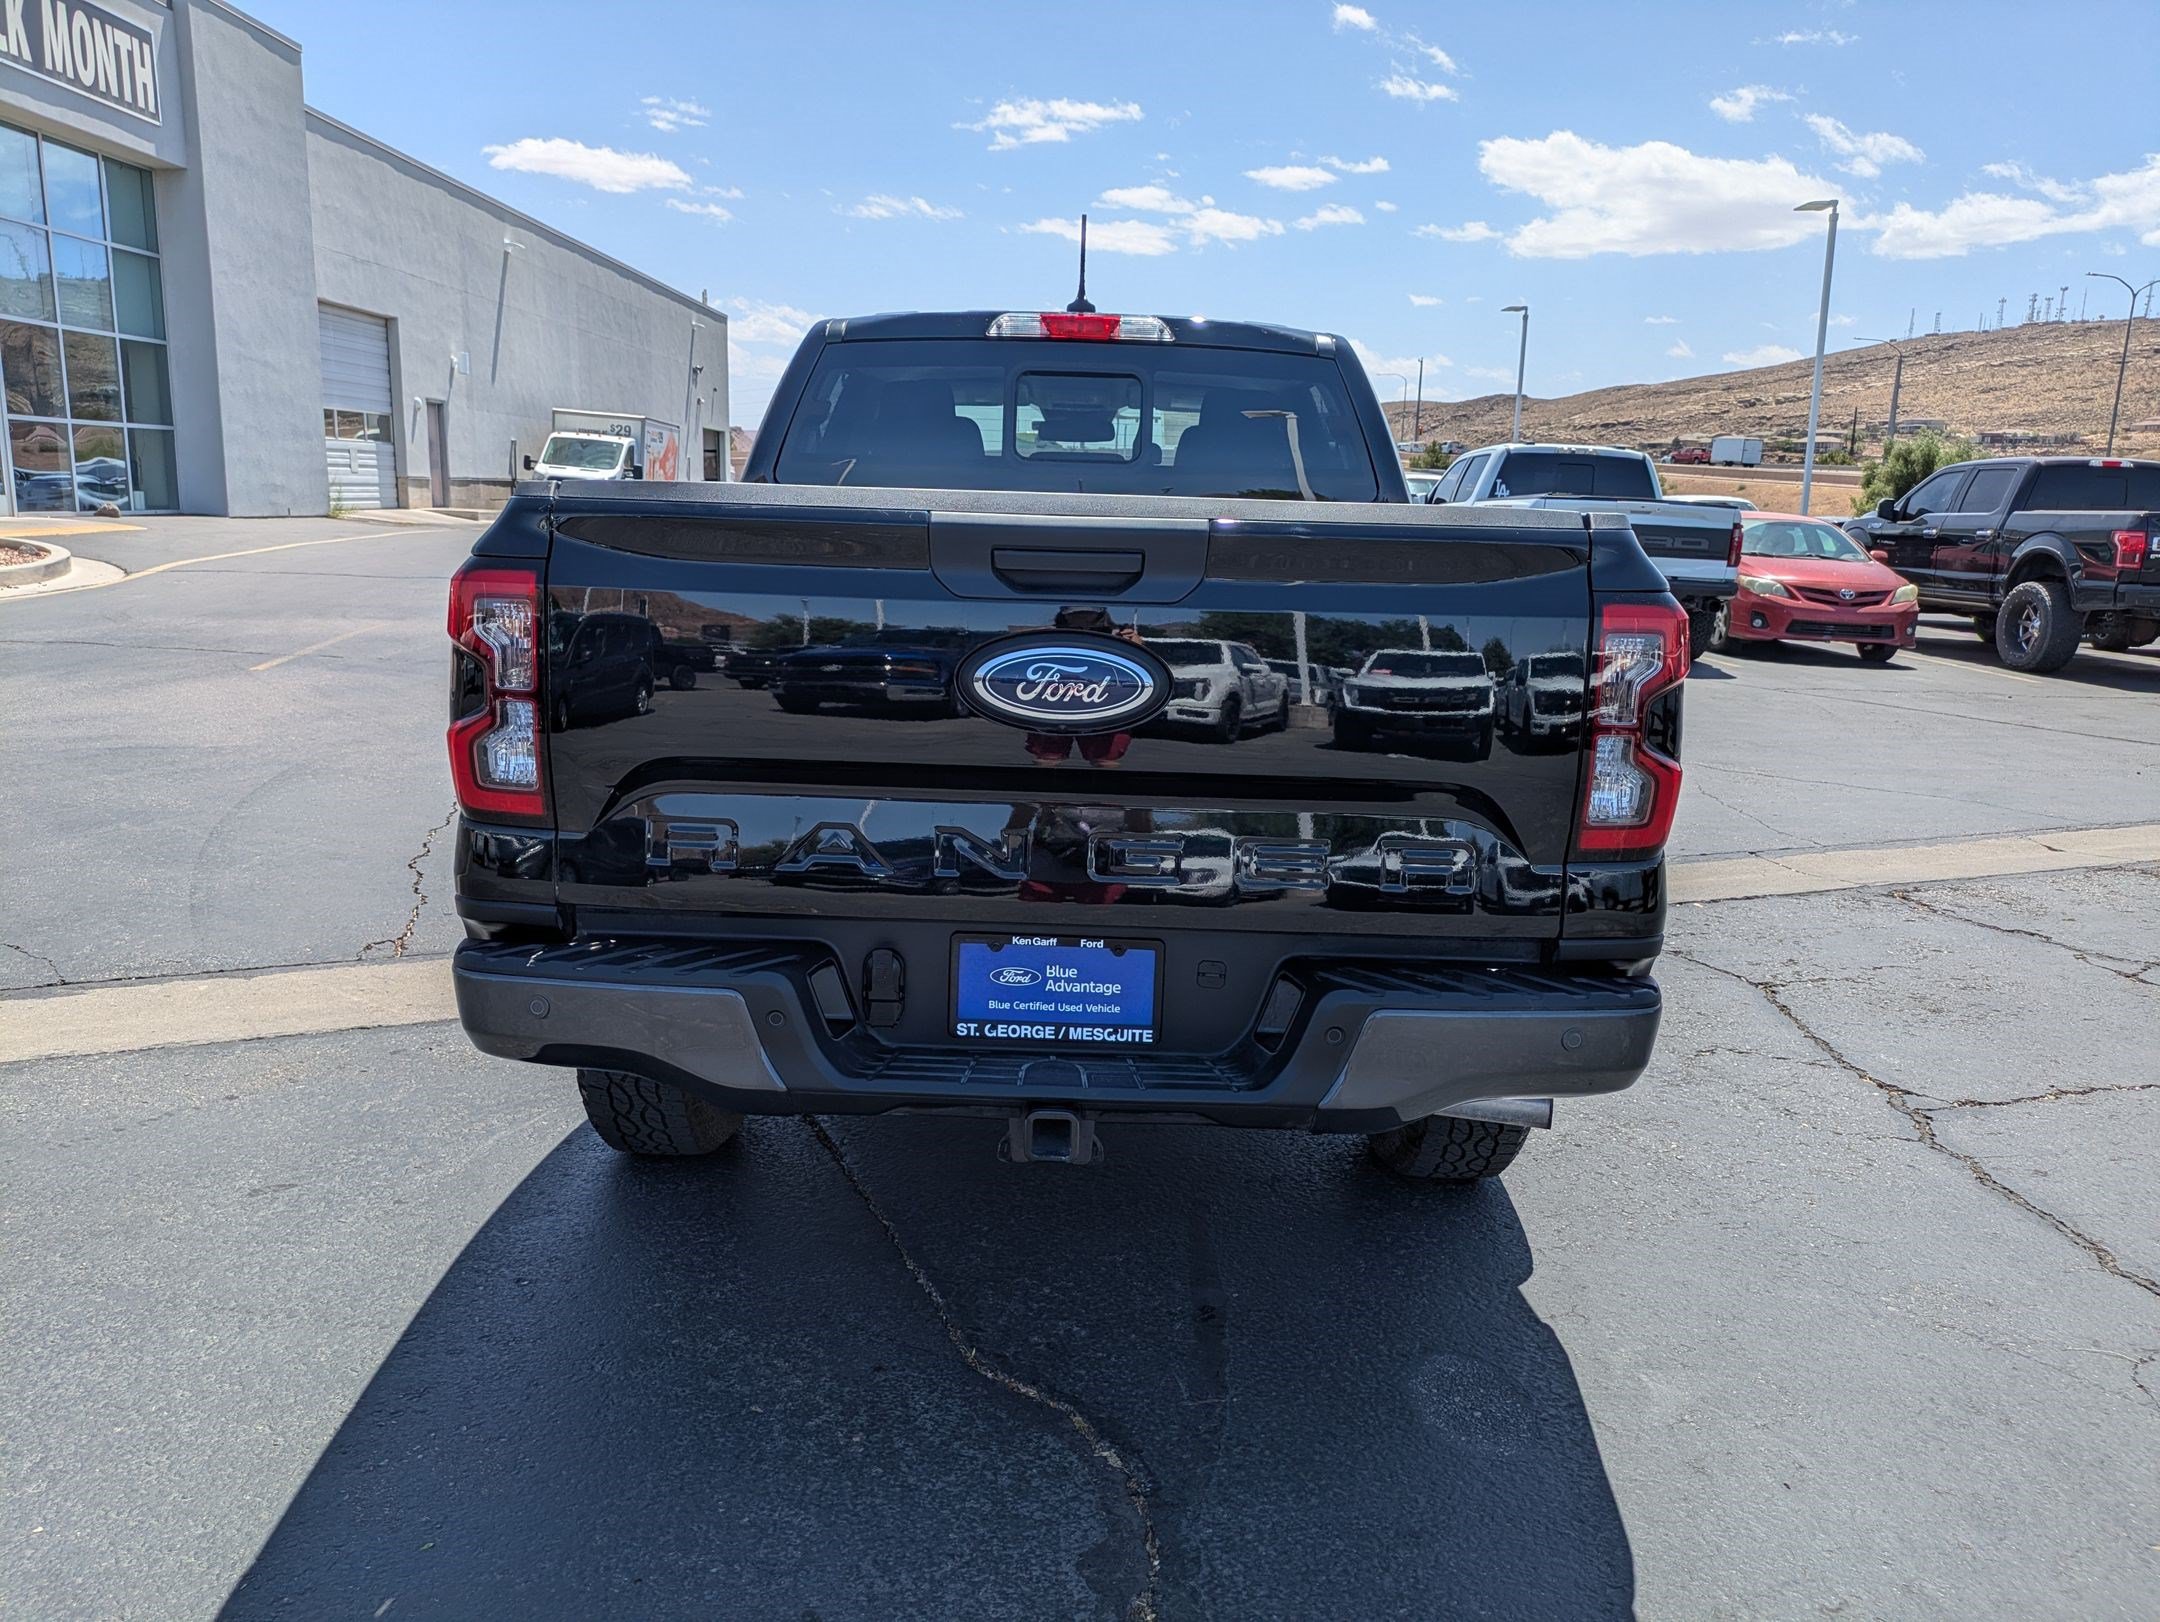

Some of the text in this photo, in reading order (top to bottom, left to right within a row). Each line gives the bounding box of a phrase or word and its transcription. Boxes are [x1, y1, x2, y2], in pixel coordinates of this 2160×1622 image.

[0, 0, 156, 114] K MONTH
[610, 424, 632, 438] $29
[1015, 662, 1111, 703] Ford
[646, 814, 1477, 894] RANGER
[1012, 936, 1104, 949] Ken Garff Ford
[1000, 968, 1032, 984] Ford
[1046, 965, 1078, 978] Blue
[1045, 979, 1121, 996] Advantage
[988, 1000, 1121, 1014] Blue Certified Used Vehicle
[956, 1023, 980, 1037] ST.
[985, 1024, 1055, 1040] GEORGE
[1069, 1027, 1153, 1043] MESQUITE
